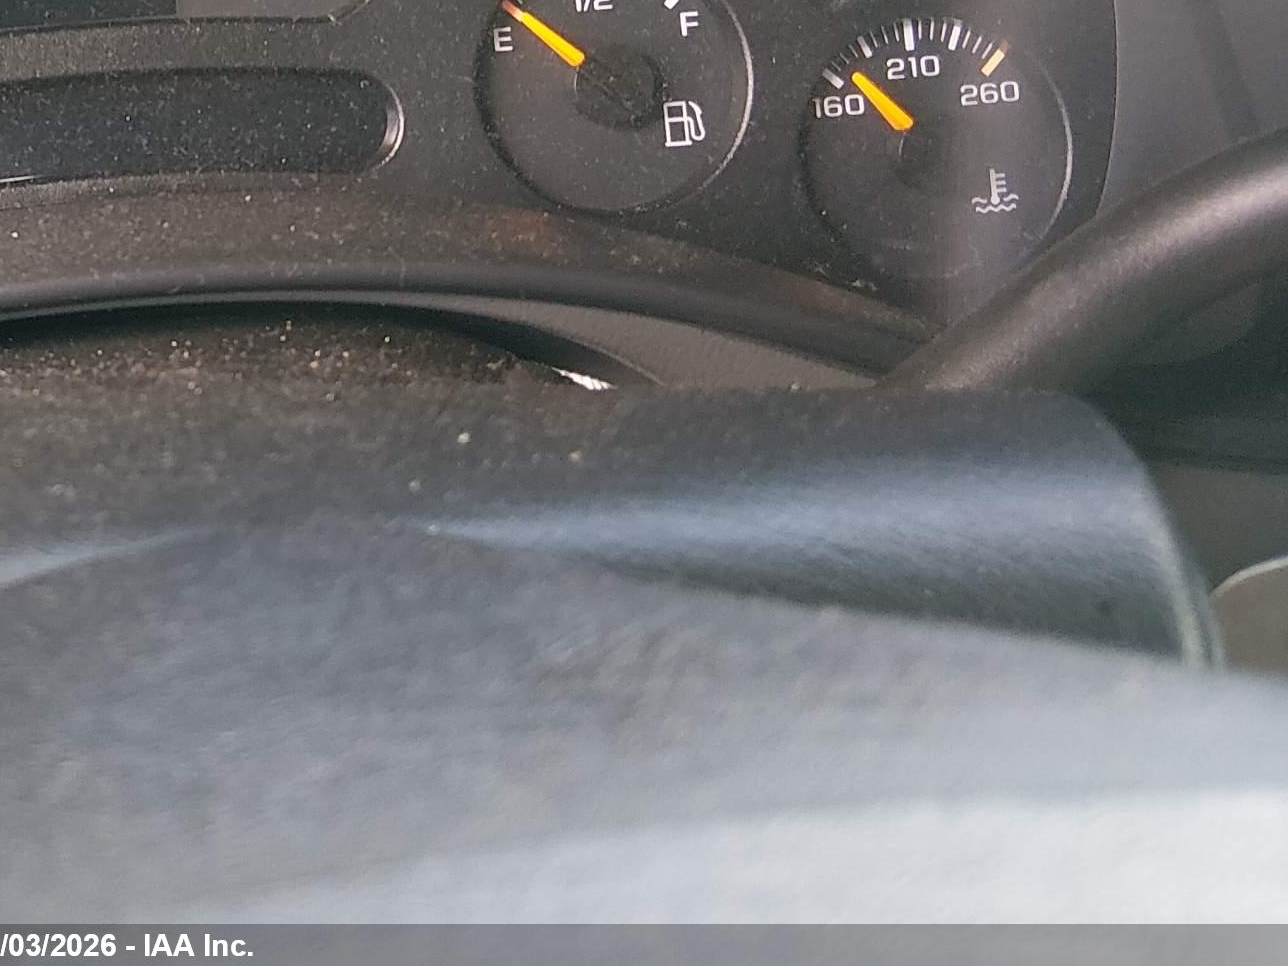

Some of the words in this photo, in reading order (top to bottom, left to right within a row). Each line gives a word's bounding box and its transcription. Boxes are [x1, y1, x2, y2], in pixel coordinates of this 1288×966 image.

[679, 10, 699, 37] F
[493, 26, 514, 52] E
[885, 54, 941, 81] 210
[812, 93, 865, 119] 160
[960, 80, 1020, 106] 260
